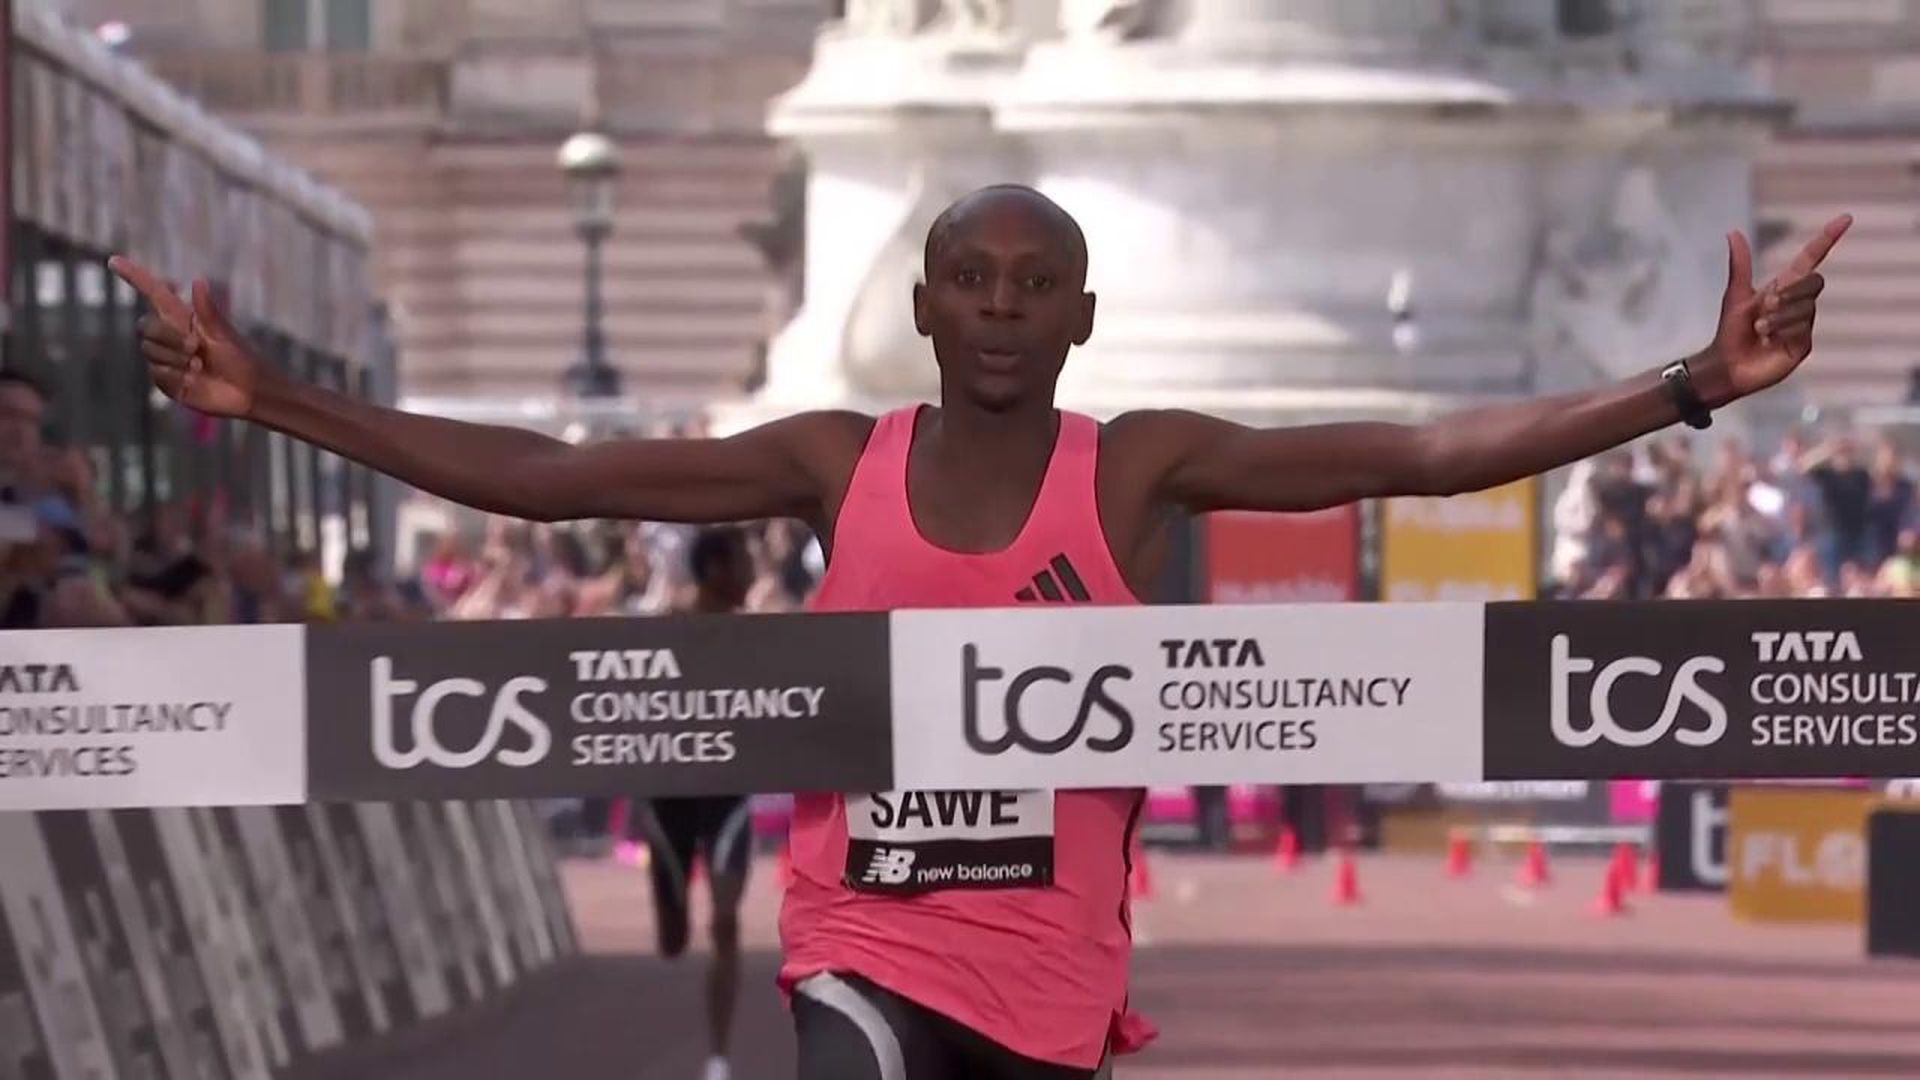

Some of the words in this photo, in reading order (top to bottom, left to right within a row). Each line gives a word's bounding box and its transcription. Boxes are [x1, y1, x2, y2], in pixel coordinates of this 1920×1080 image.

[1160, 638, 1264, 668] TATA
[1751, 631, 1863, 661] TATA
[569, 648, 682, 681] TATA
[570, 686, 825, 723] CONSULTANCY
[961, 643, 1133, 755] tcs
[1158, 677, 1411, 710] CONSULTANCY
[1550, 634, 1728, 747] tcs
[1750, 672, 1920, 704] CONSULT
[371, 656, 552, 769] tcs
[1157, 720, 1317, 751] SERVICES
[1751, 714, 1918, 745] SERVICES
[571, 731, 736, 766] SERVICES
[870, 790, 1019, 829] SAWE
[917, 867, 954, 883] new
[957, 862, 1033, 881] balance
